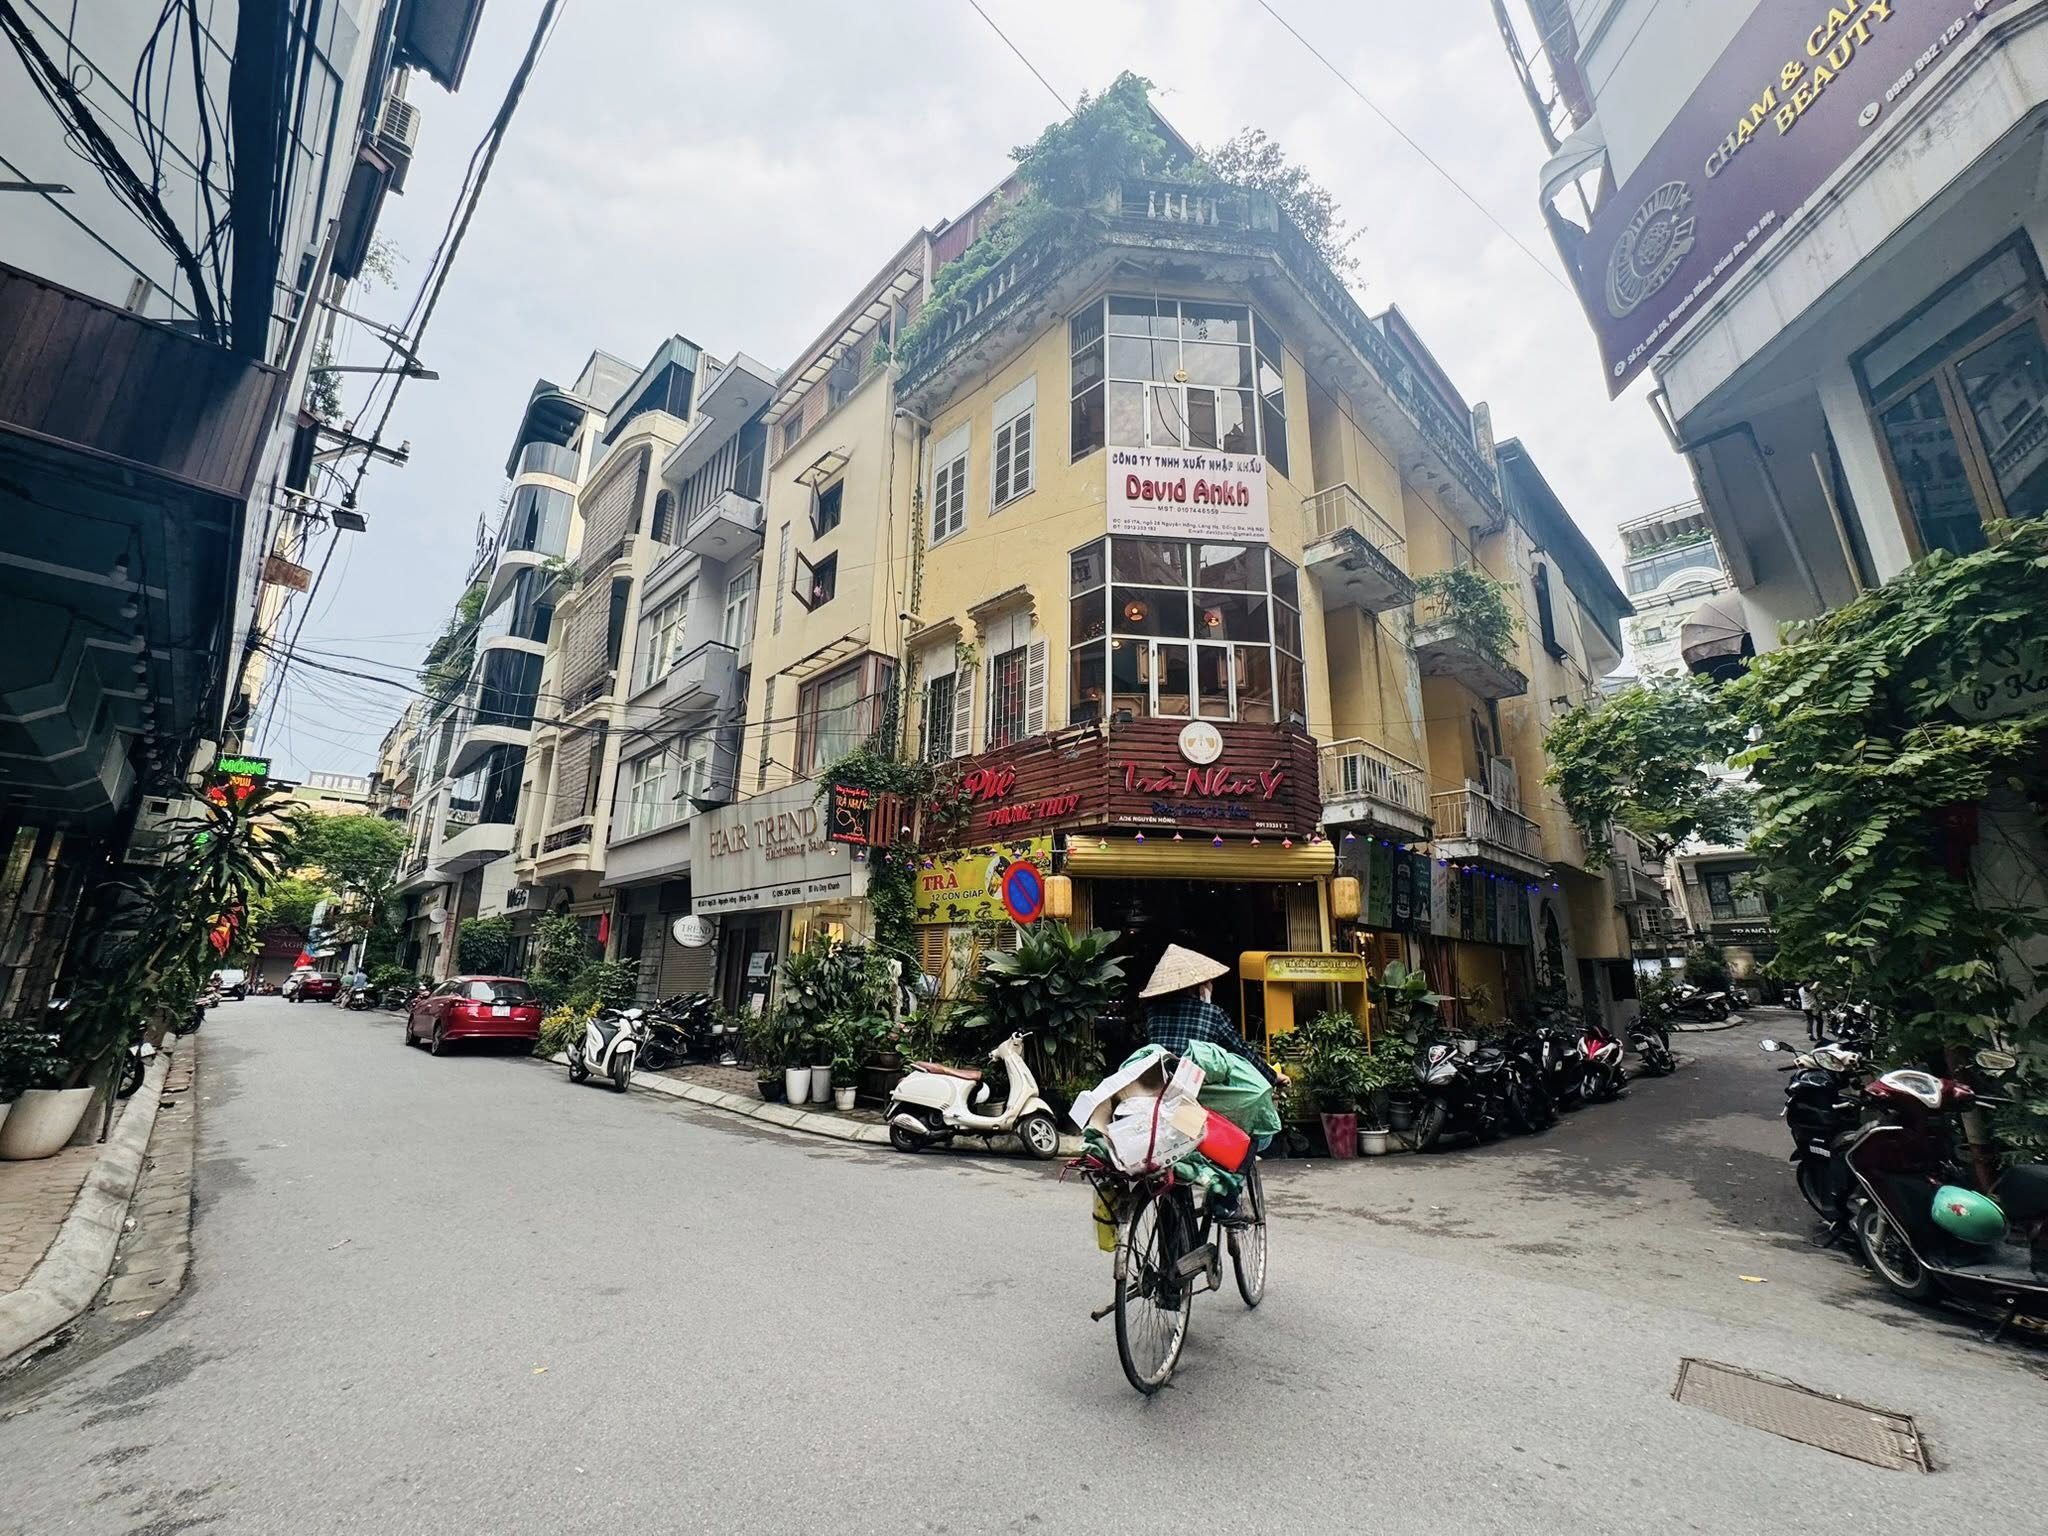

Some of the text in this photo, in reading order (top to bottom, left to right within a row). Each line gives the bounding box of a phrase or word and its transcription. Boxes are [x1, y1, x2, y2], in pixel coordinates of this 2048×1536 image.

[1774, 0, 1895, 136] BEAUTY
[1915, 43, 1942, 73] 992
[1705, 85, 1778, 179] CHẠM
[1780, 60, 1806, 91] &
[1112, 453, 1137, 465] CÔNG
[1140, 456, 1151, 466] TY
[1155, 457, 1180, 468] TNHH
[1183, 455, 1206, 469] XUẤT
[1126, 474, 1249, 507] David Ankh
[1119, 760, 1178, 792] Trà
[710, 806, 819, 859] HAIR TREND
[922, 870, 959, 891] TRÀ
[942, 891, 960, 900] CON
